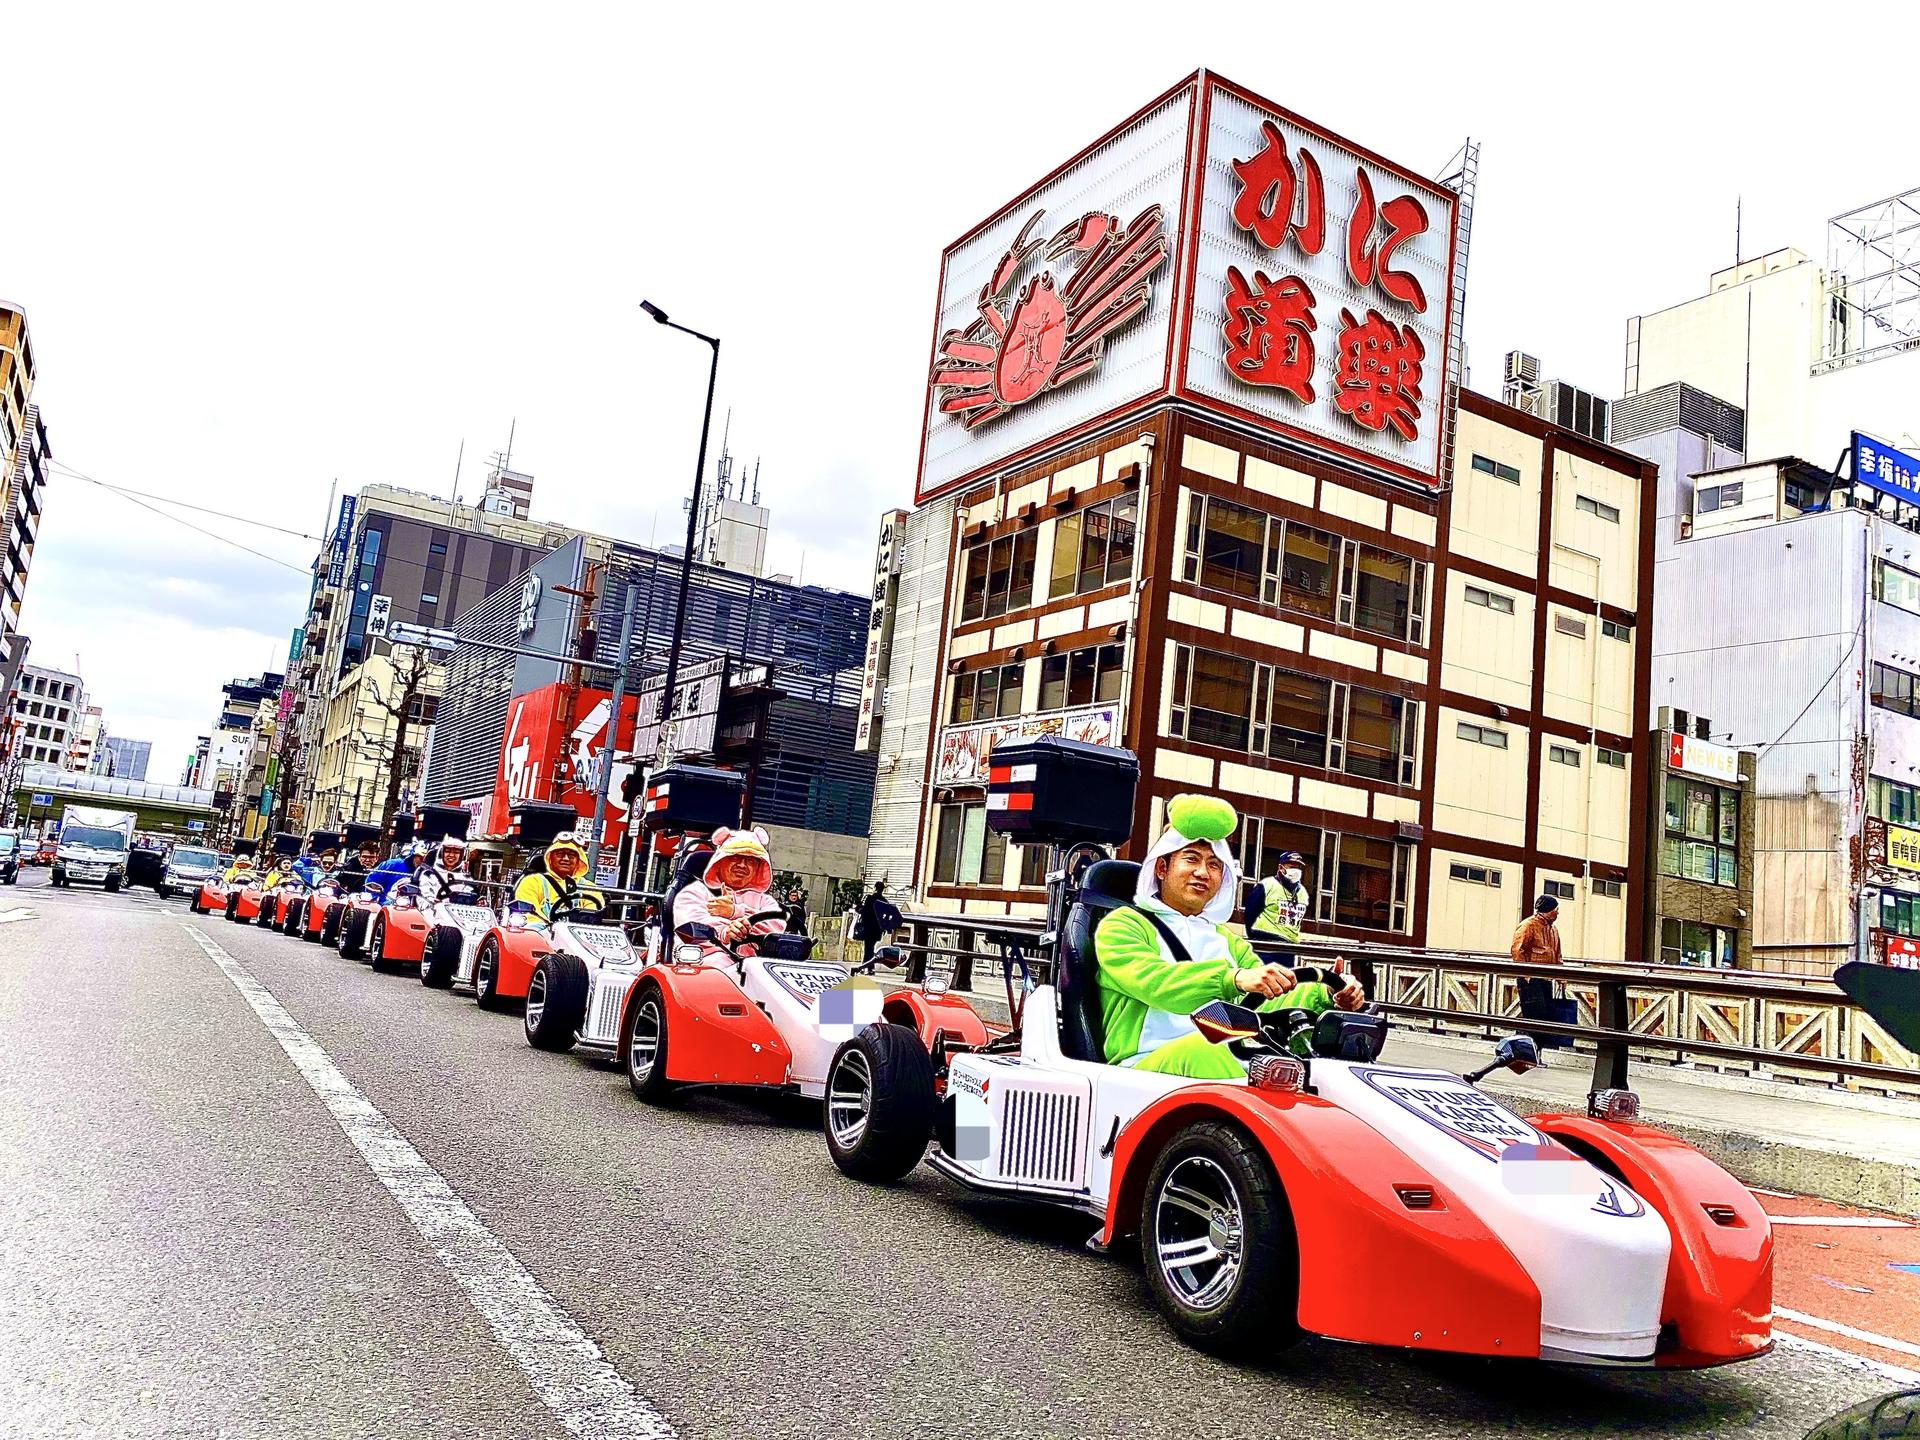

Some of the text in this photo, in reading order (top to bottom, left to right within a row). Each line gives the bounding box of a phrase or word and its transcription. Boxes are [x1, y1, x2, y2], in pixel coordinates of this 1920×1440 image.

[1231, 120, 1429, 314] かに
[1387, 1085, 1496, 1107] FUTURE
[1424, 1103, 1507, 1124] KART
[1453, 1121, 1530, 1137] OSAKA
